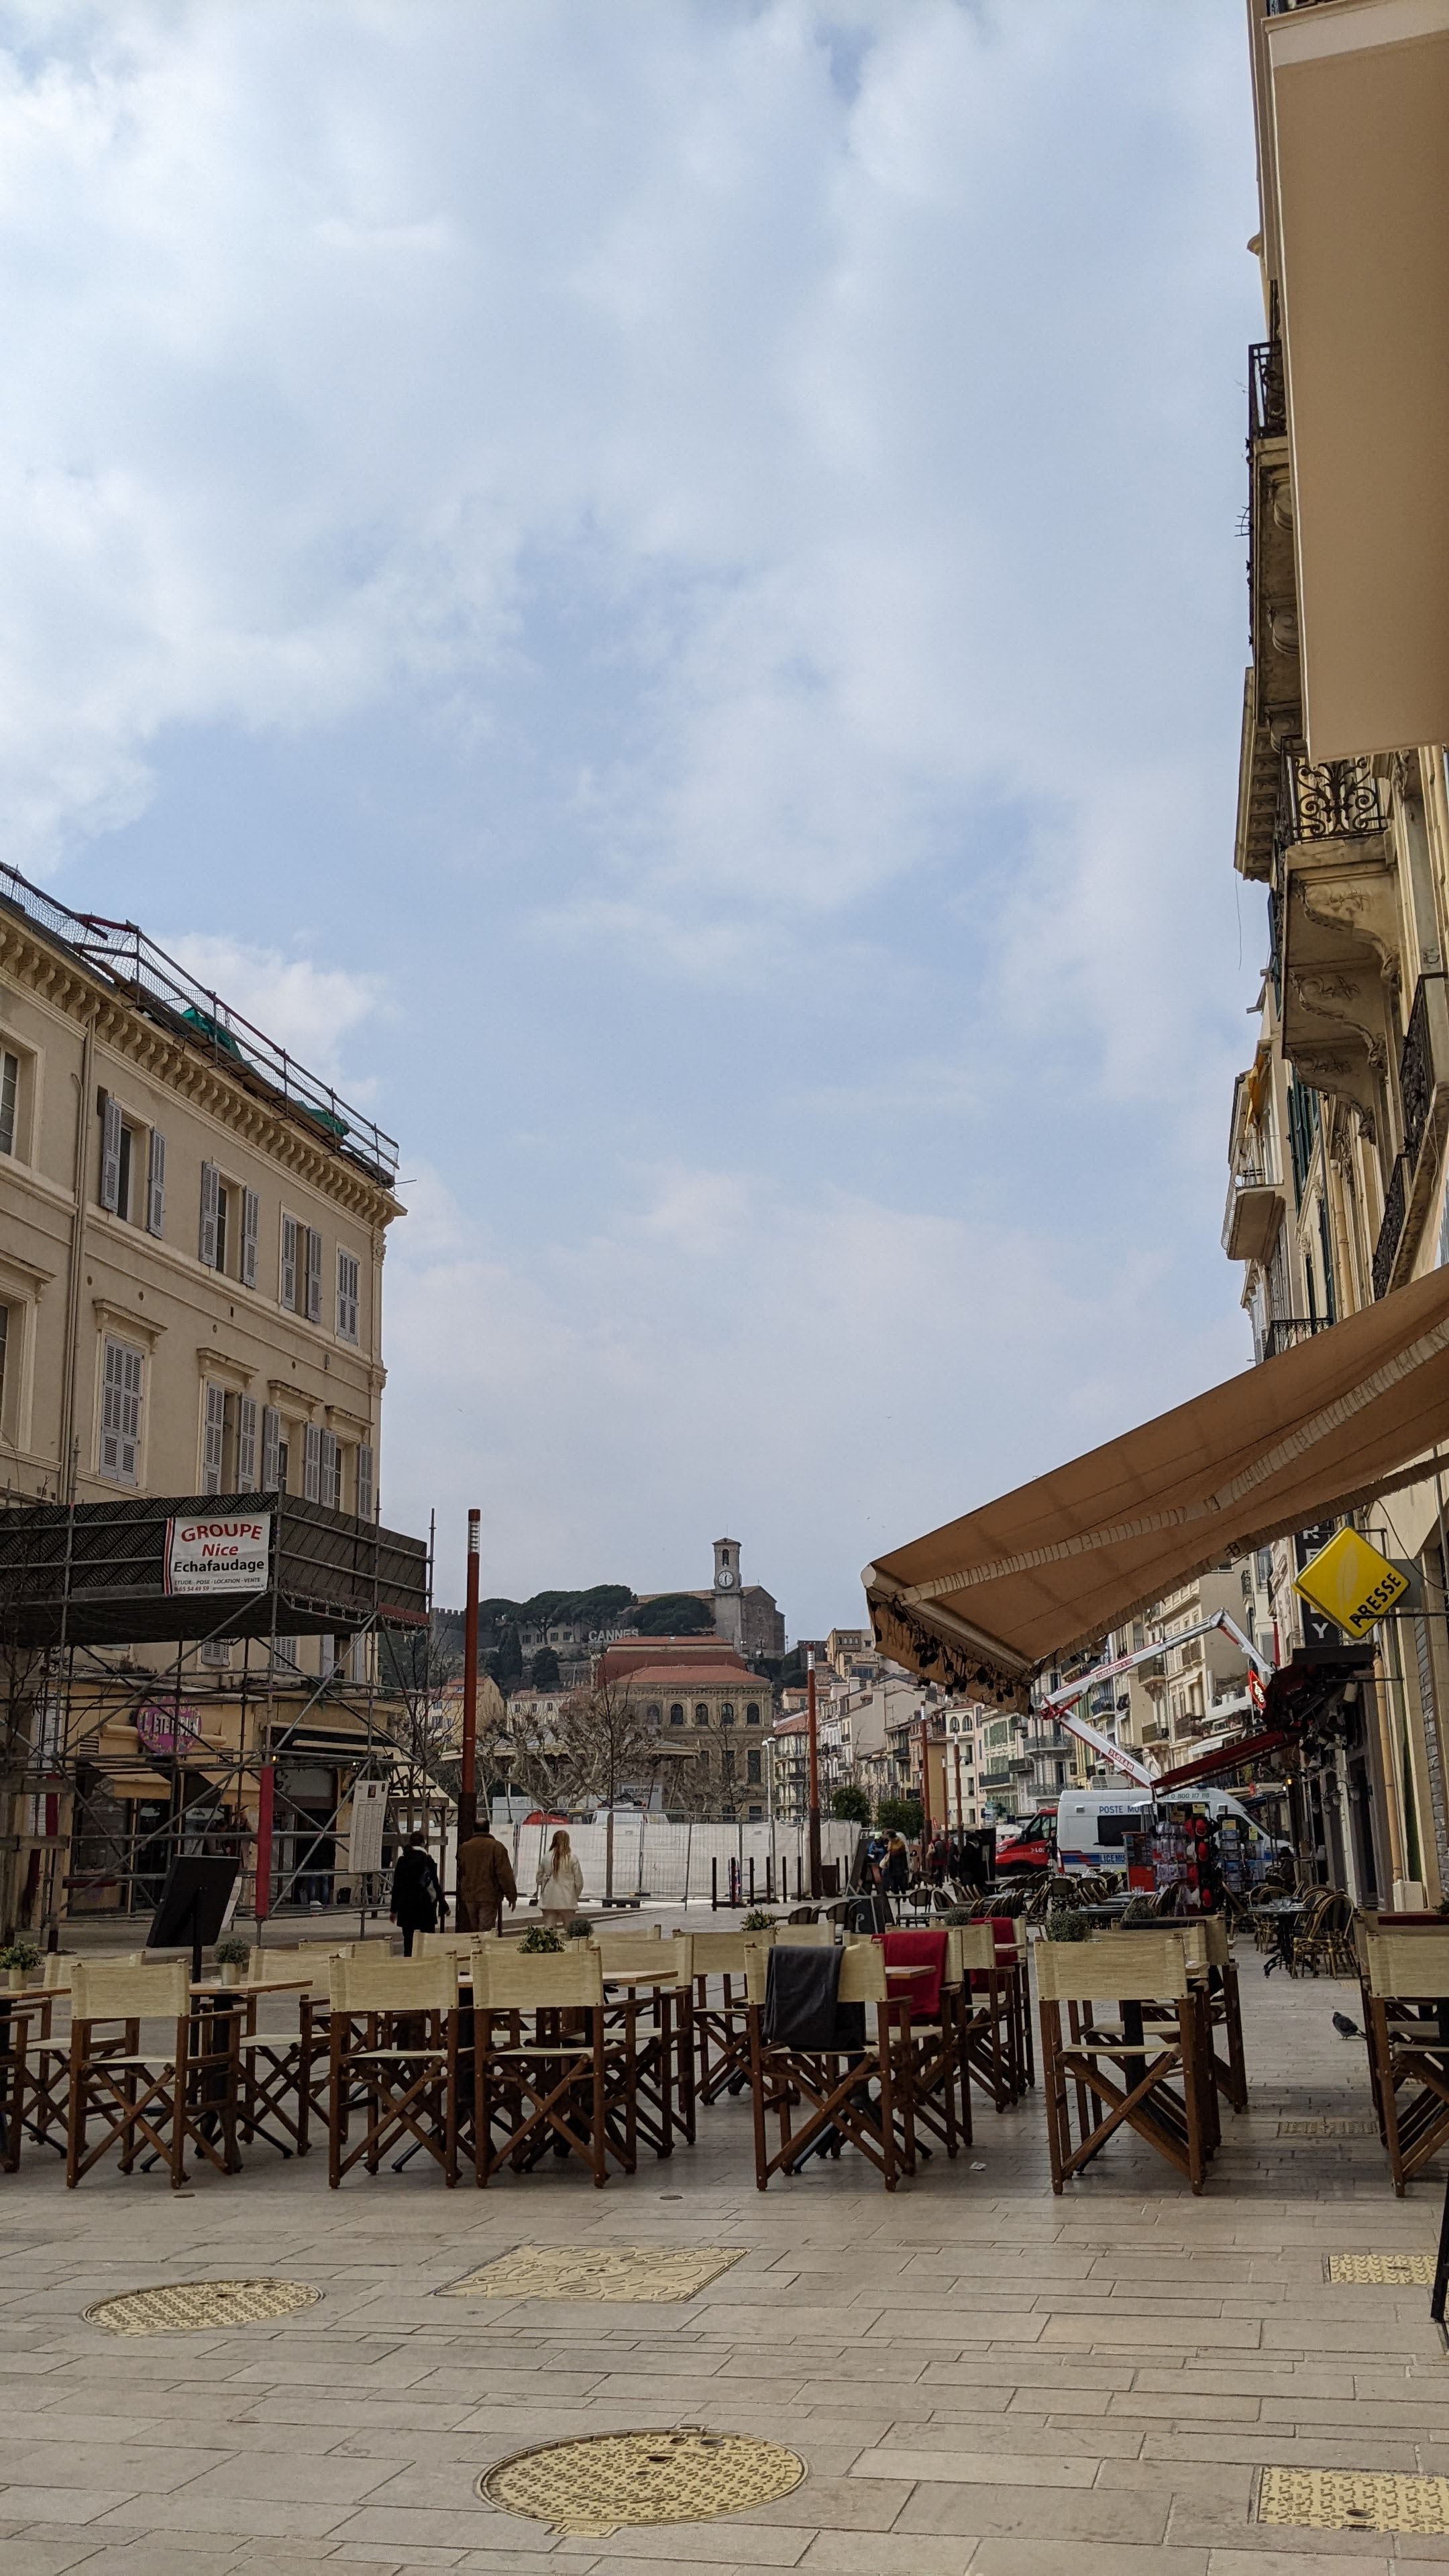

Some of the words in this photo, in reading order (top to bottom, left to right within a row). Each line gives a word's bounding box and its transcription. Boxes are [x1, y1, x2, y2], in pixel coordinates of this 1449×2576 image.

[181, 1523, 263, 1542] GROUPE
[202, 1544, 239, 1557] Nice
[174, 1559, 264, 1573] Echafaudage
[1348, 1572, 1401, 1629] PRESSE
[588, 1627, 639, 1642] CANNES
[1112, 1752, 1134, 1771] LOXAM
[1099, 1805, 1124, 1814] POSTE
